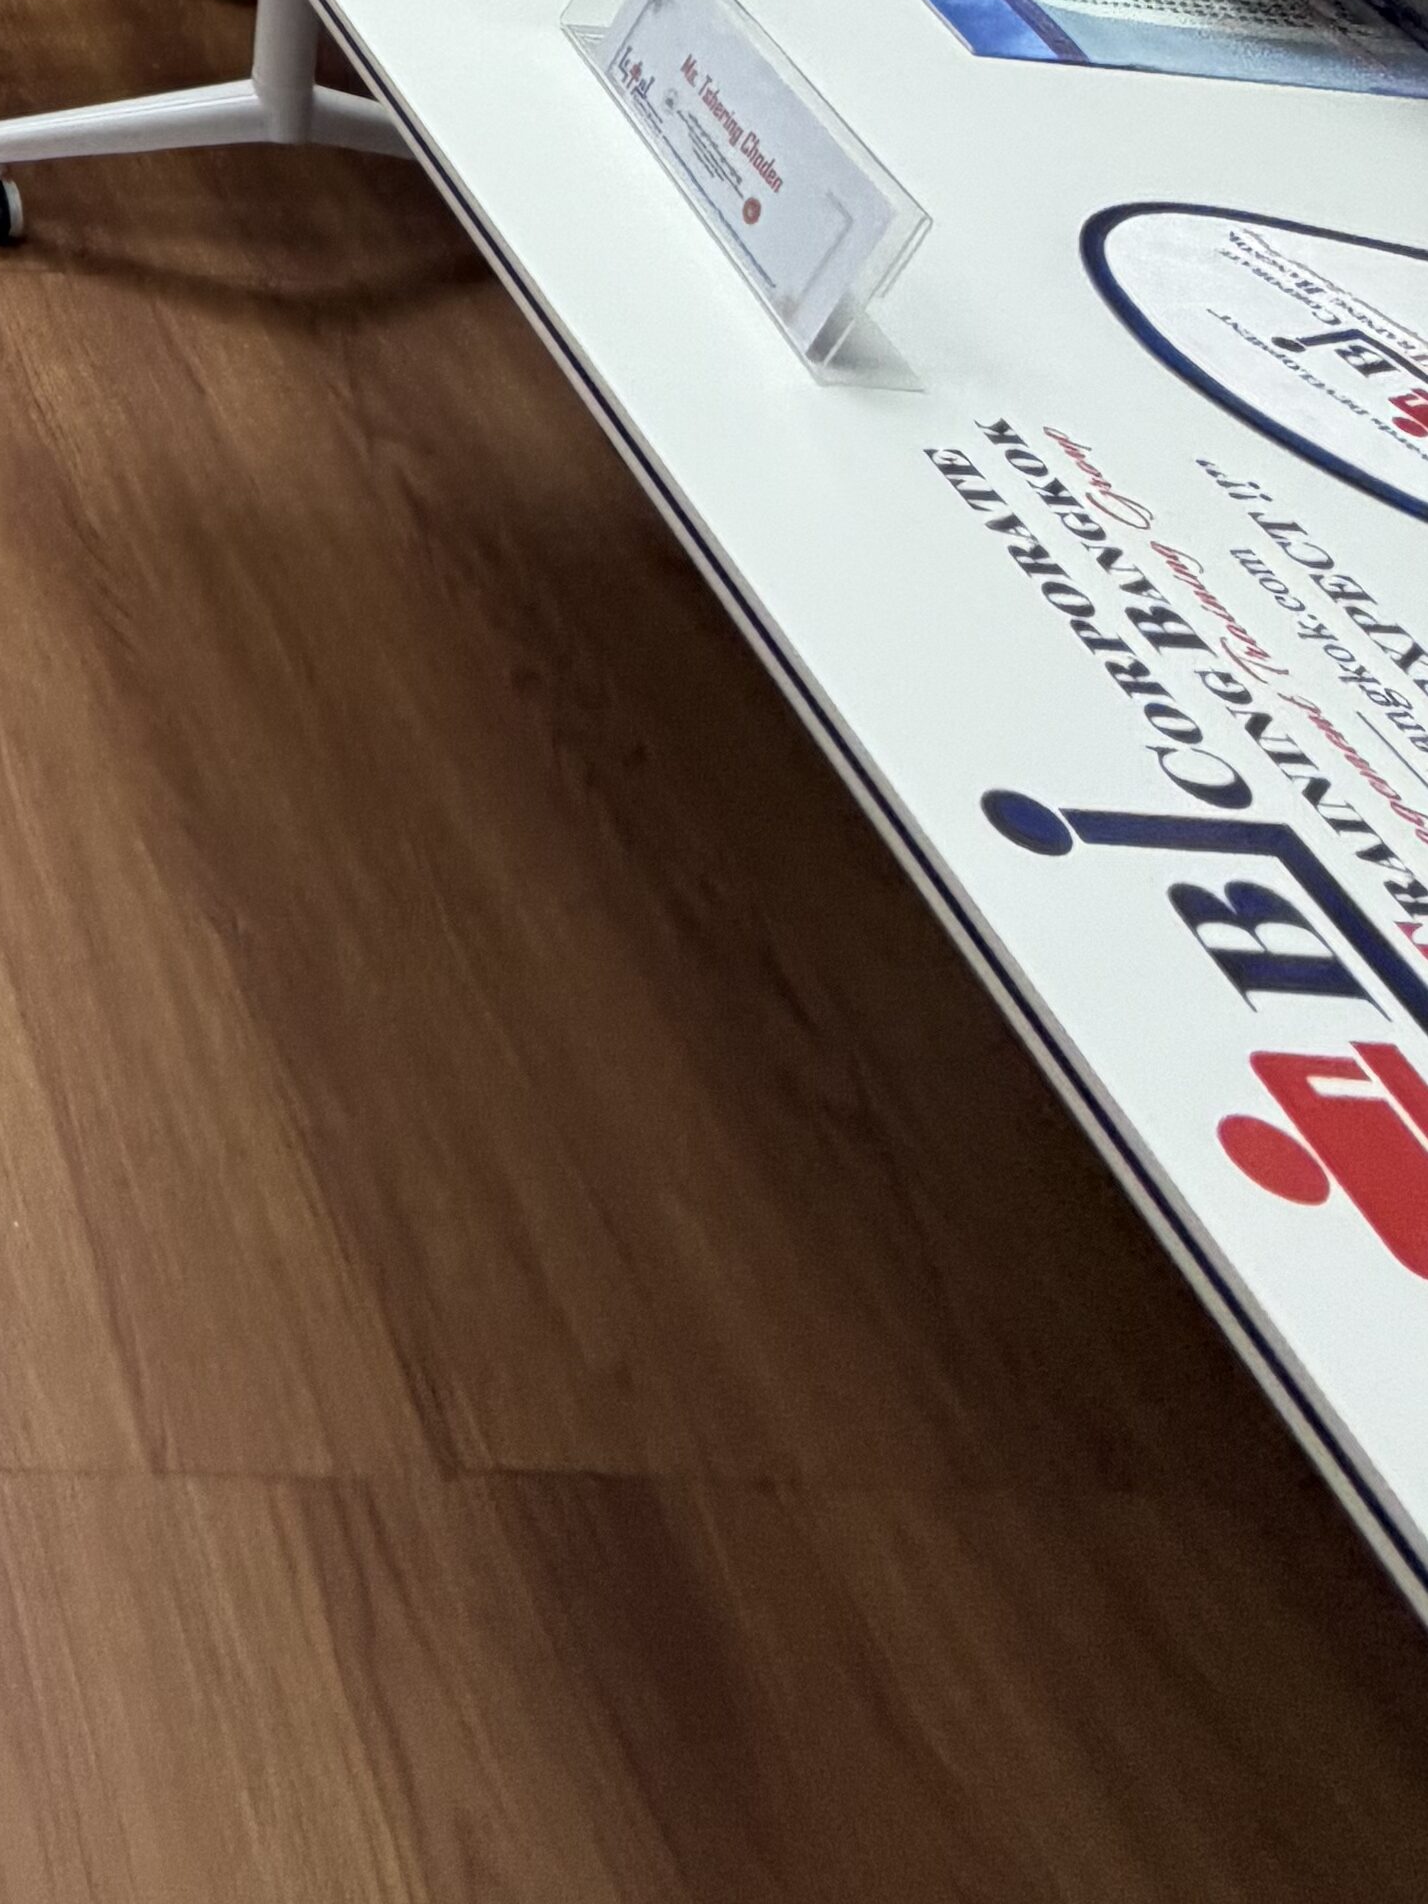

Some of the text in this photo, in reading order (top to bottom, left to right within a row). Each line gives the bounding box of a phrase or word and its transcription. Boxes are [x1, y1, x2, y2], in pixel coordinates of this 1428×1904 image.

[699, 74, 744, 148] Tshering
[974, 418, 1219, 659] BANGKOK
[1043, 426, 1154, 530] Group
[923, 448, 1253, 810] CORPORATE
[1150, 540, 1290, 684] Training
